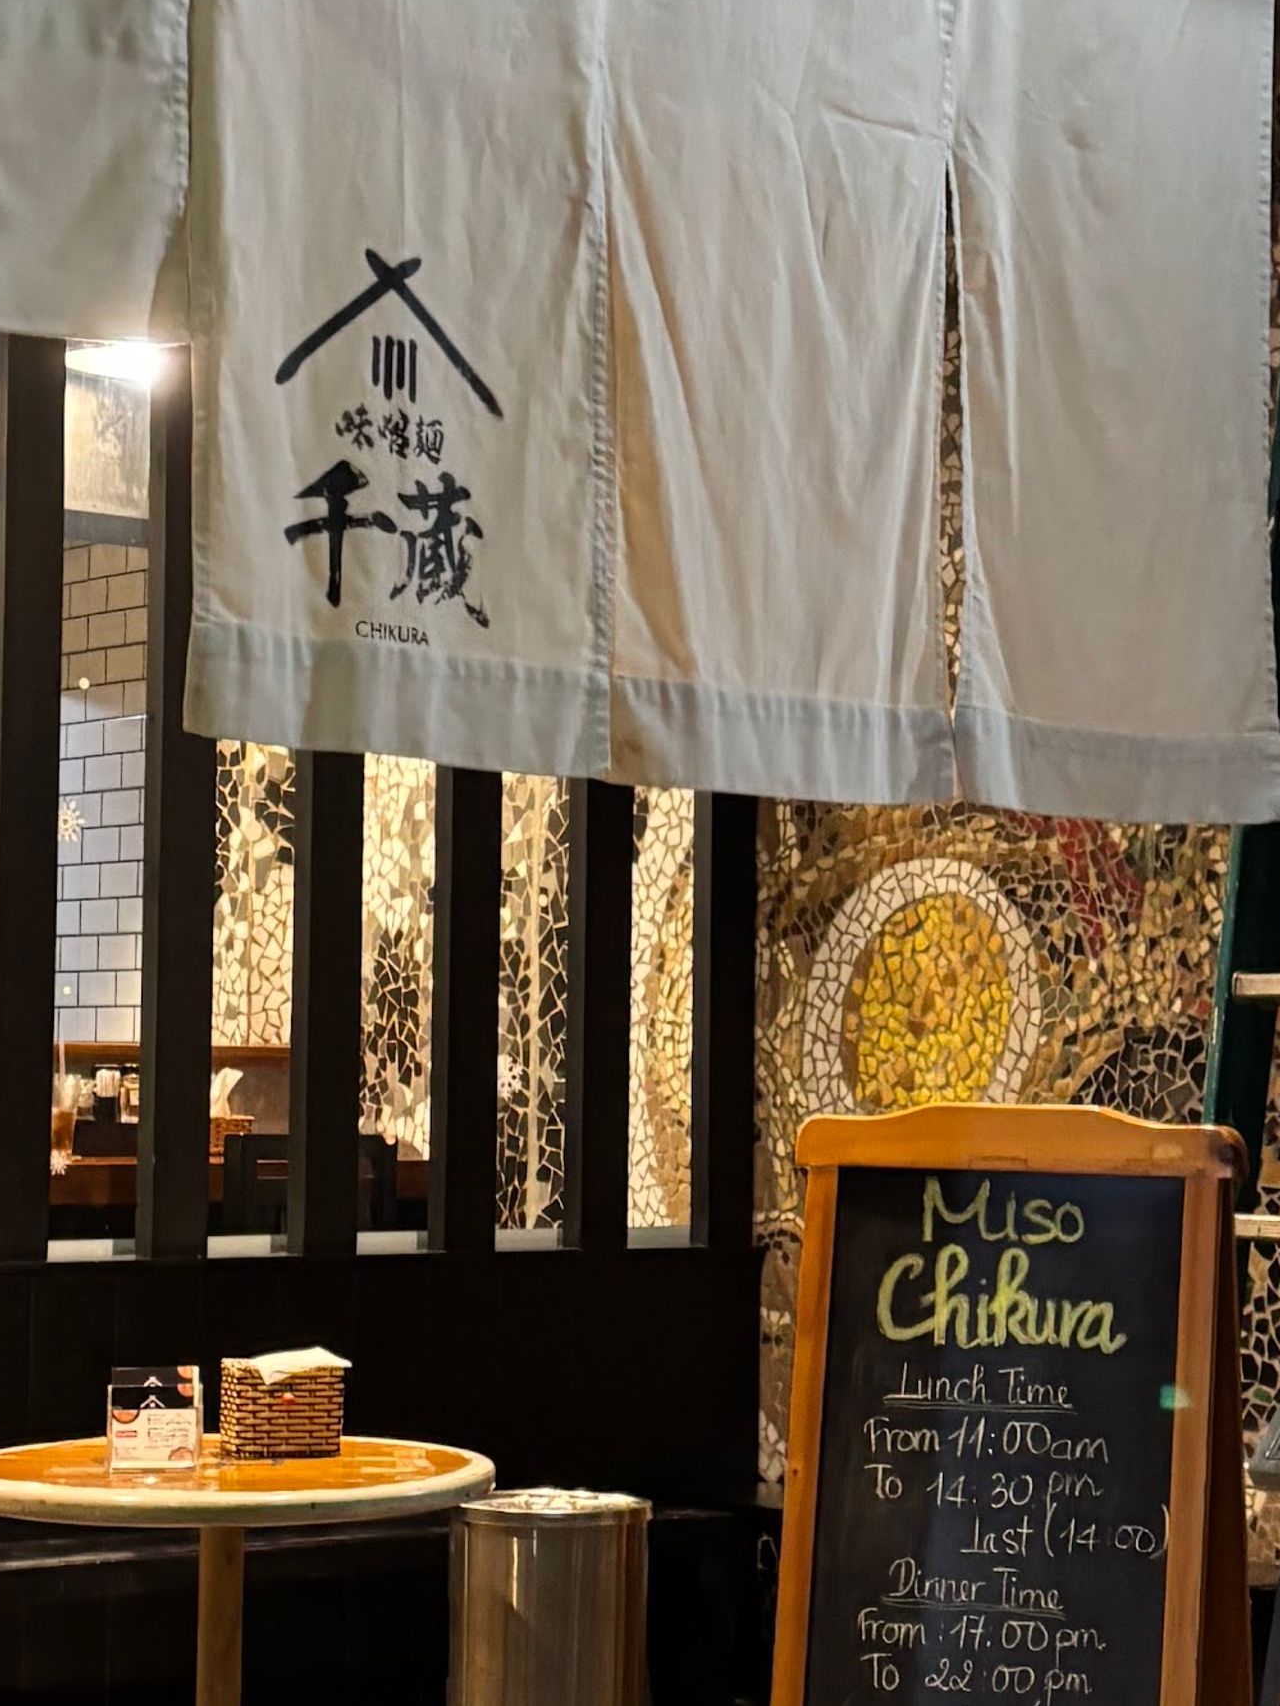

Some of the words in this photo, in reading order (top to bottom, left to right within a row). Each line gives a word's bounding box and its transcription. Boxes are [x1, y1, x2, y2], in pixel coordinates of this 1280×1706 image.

[284, 459, 491, 629] 千蔵
[355, 619, 431, 648] CHIKURA
[922, 1176, 1085, 1244] Miso
[876, 1244, 1127, 1354] Chikura
[882, 1363, 990, 1403] Lunch
[999, 1368, 1074, 1408] Time
[863, 1417, 940, 1455] From
[864, 1464, 903, 1499] To
[960, 1515, 1034, 1558] Last
[888, 1557, 986, 1601] Dinner
[993, 1567, 1064, 1611] Time
[860, 1653, 900, 1691] To
